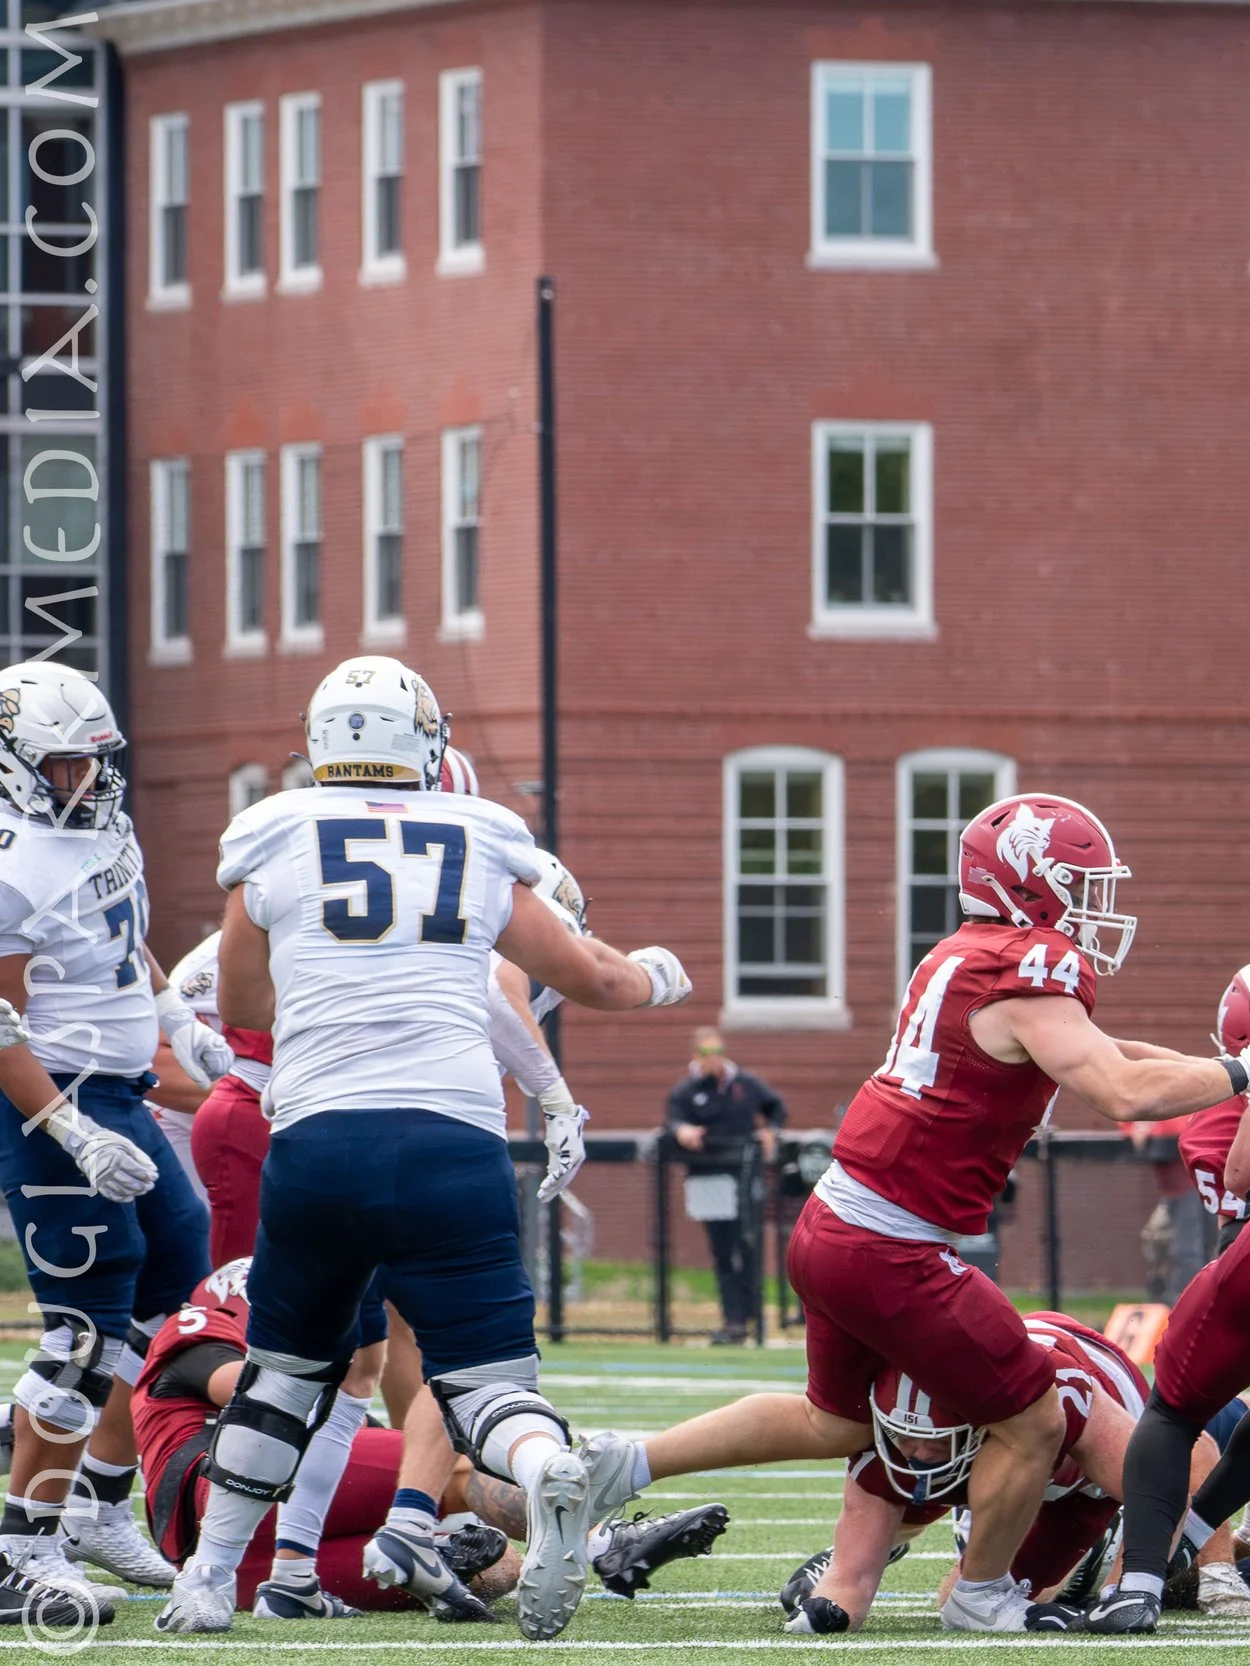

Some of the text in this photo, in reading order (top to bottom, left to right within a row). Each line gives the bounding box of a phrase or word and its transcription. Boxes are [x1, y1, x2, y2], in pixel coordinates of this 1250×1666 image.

[346, 669, 376, 685] 57
[327, 764, 395, 778] BANTAMS
[312, 818, 472, 944] 57
[1017, 943, 1081, 995] 44
[1194, 1168, 1246, 1219] 54
[225, 1478, 273, 1496] DONJOY
